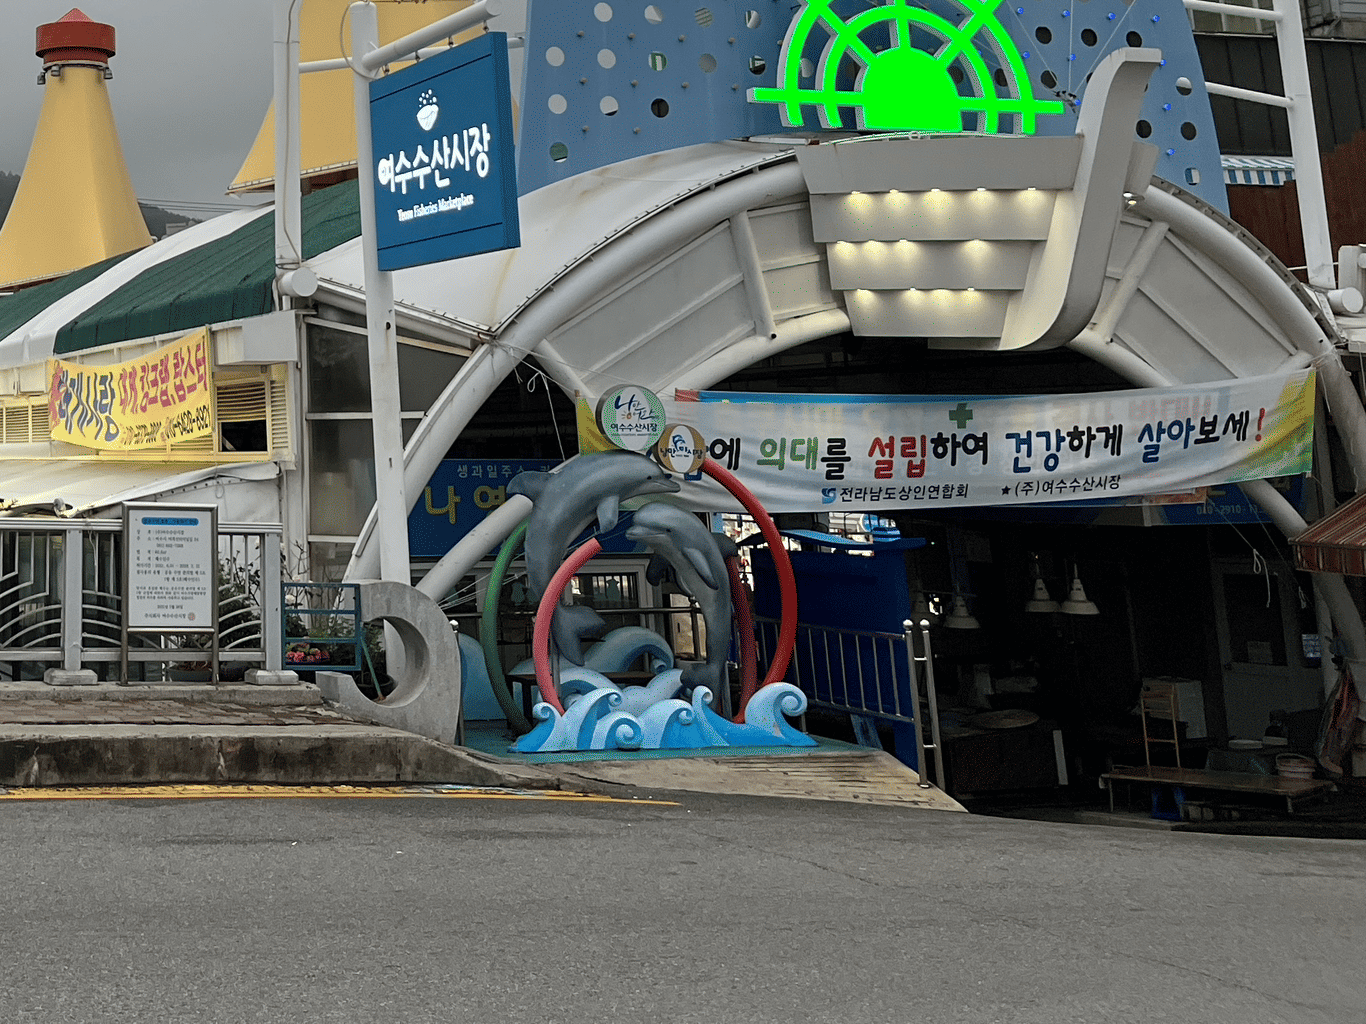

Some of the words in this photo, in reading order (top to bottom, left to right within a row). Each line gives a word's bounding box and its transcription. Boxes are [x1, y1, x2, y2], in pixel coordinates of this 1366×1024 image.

[378, 123, 491, 195] 여수수산시장
[610, 422, 658, 433] 여수수산시장
[756, 437, 851, 480] 의대를
[868, 432, 989, 480] 설립하여
[1005, 424, 1123, 474] 건강하게
[1137, 407, 1266, 464] 살아보세!
[840, 483, 969, 503] 전라남도상인연합회
[1014, 475, 1122, 498] (주)여수수산시장
